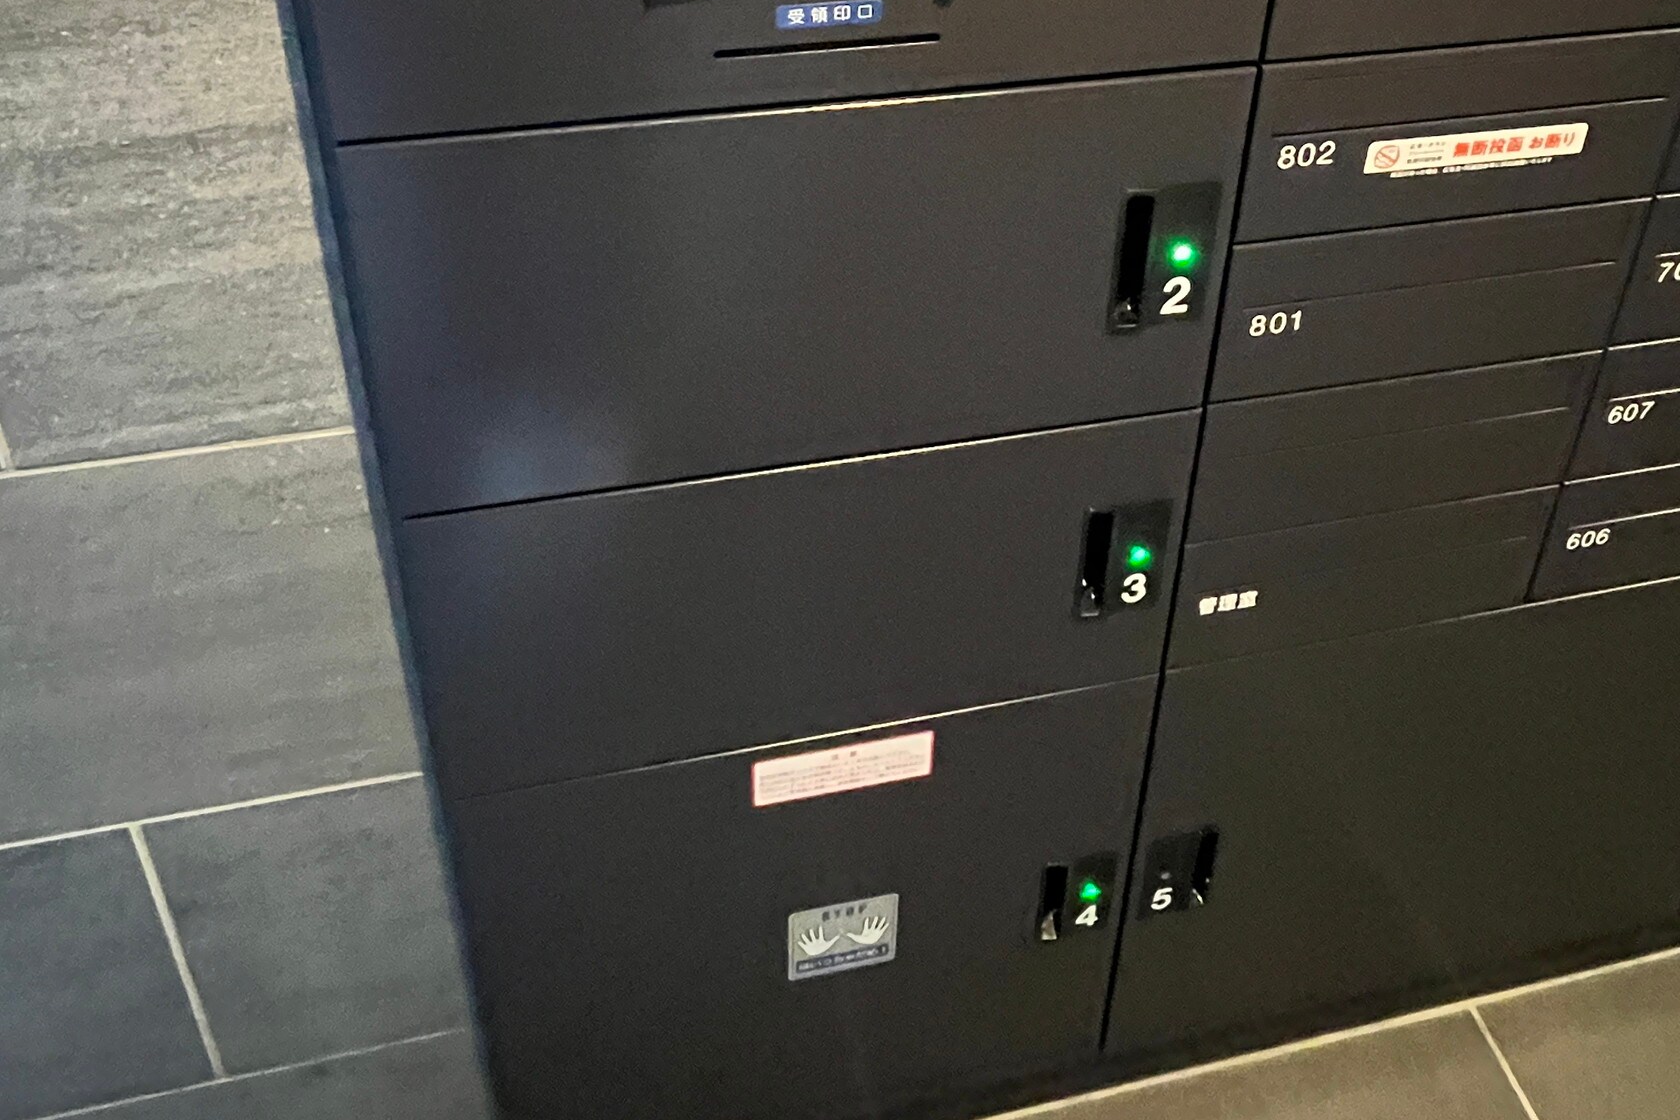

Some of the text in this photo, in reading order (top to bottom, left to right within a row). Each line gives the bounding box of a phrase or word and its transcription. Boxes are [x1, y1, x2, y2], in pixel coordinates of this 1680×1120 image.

[788, 5, 872, 25] 受領印口
[1277, 140, 1335, 169] 802
[1160, 276, 1190, 314] 2
[1250, 310, 1302, 337] 801
[1607, 400, 1655, 424] 607
[1566, 528, 1611, 549] 606
[1121, 573, 1147, 603] 3
[1150, 887, 1173, 910] 5
[1075, 905, 1098, 926] 4
